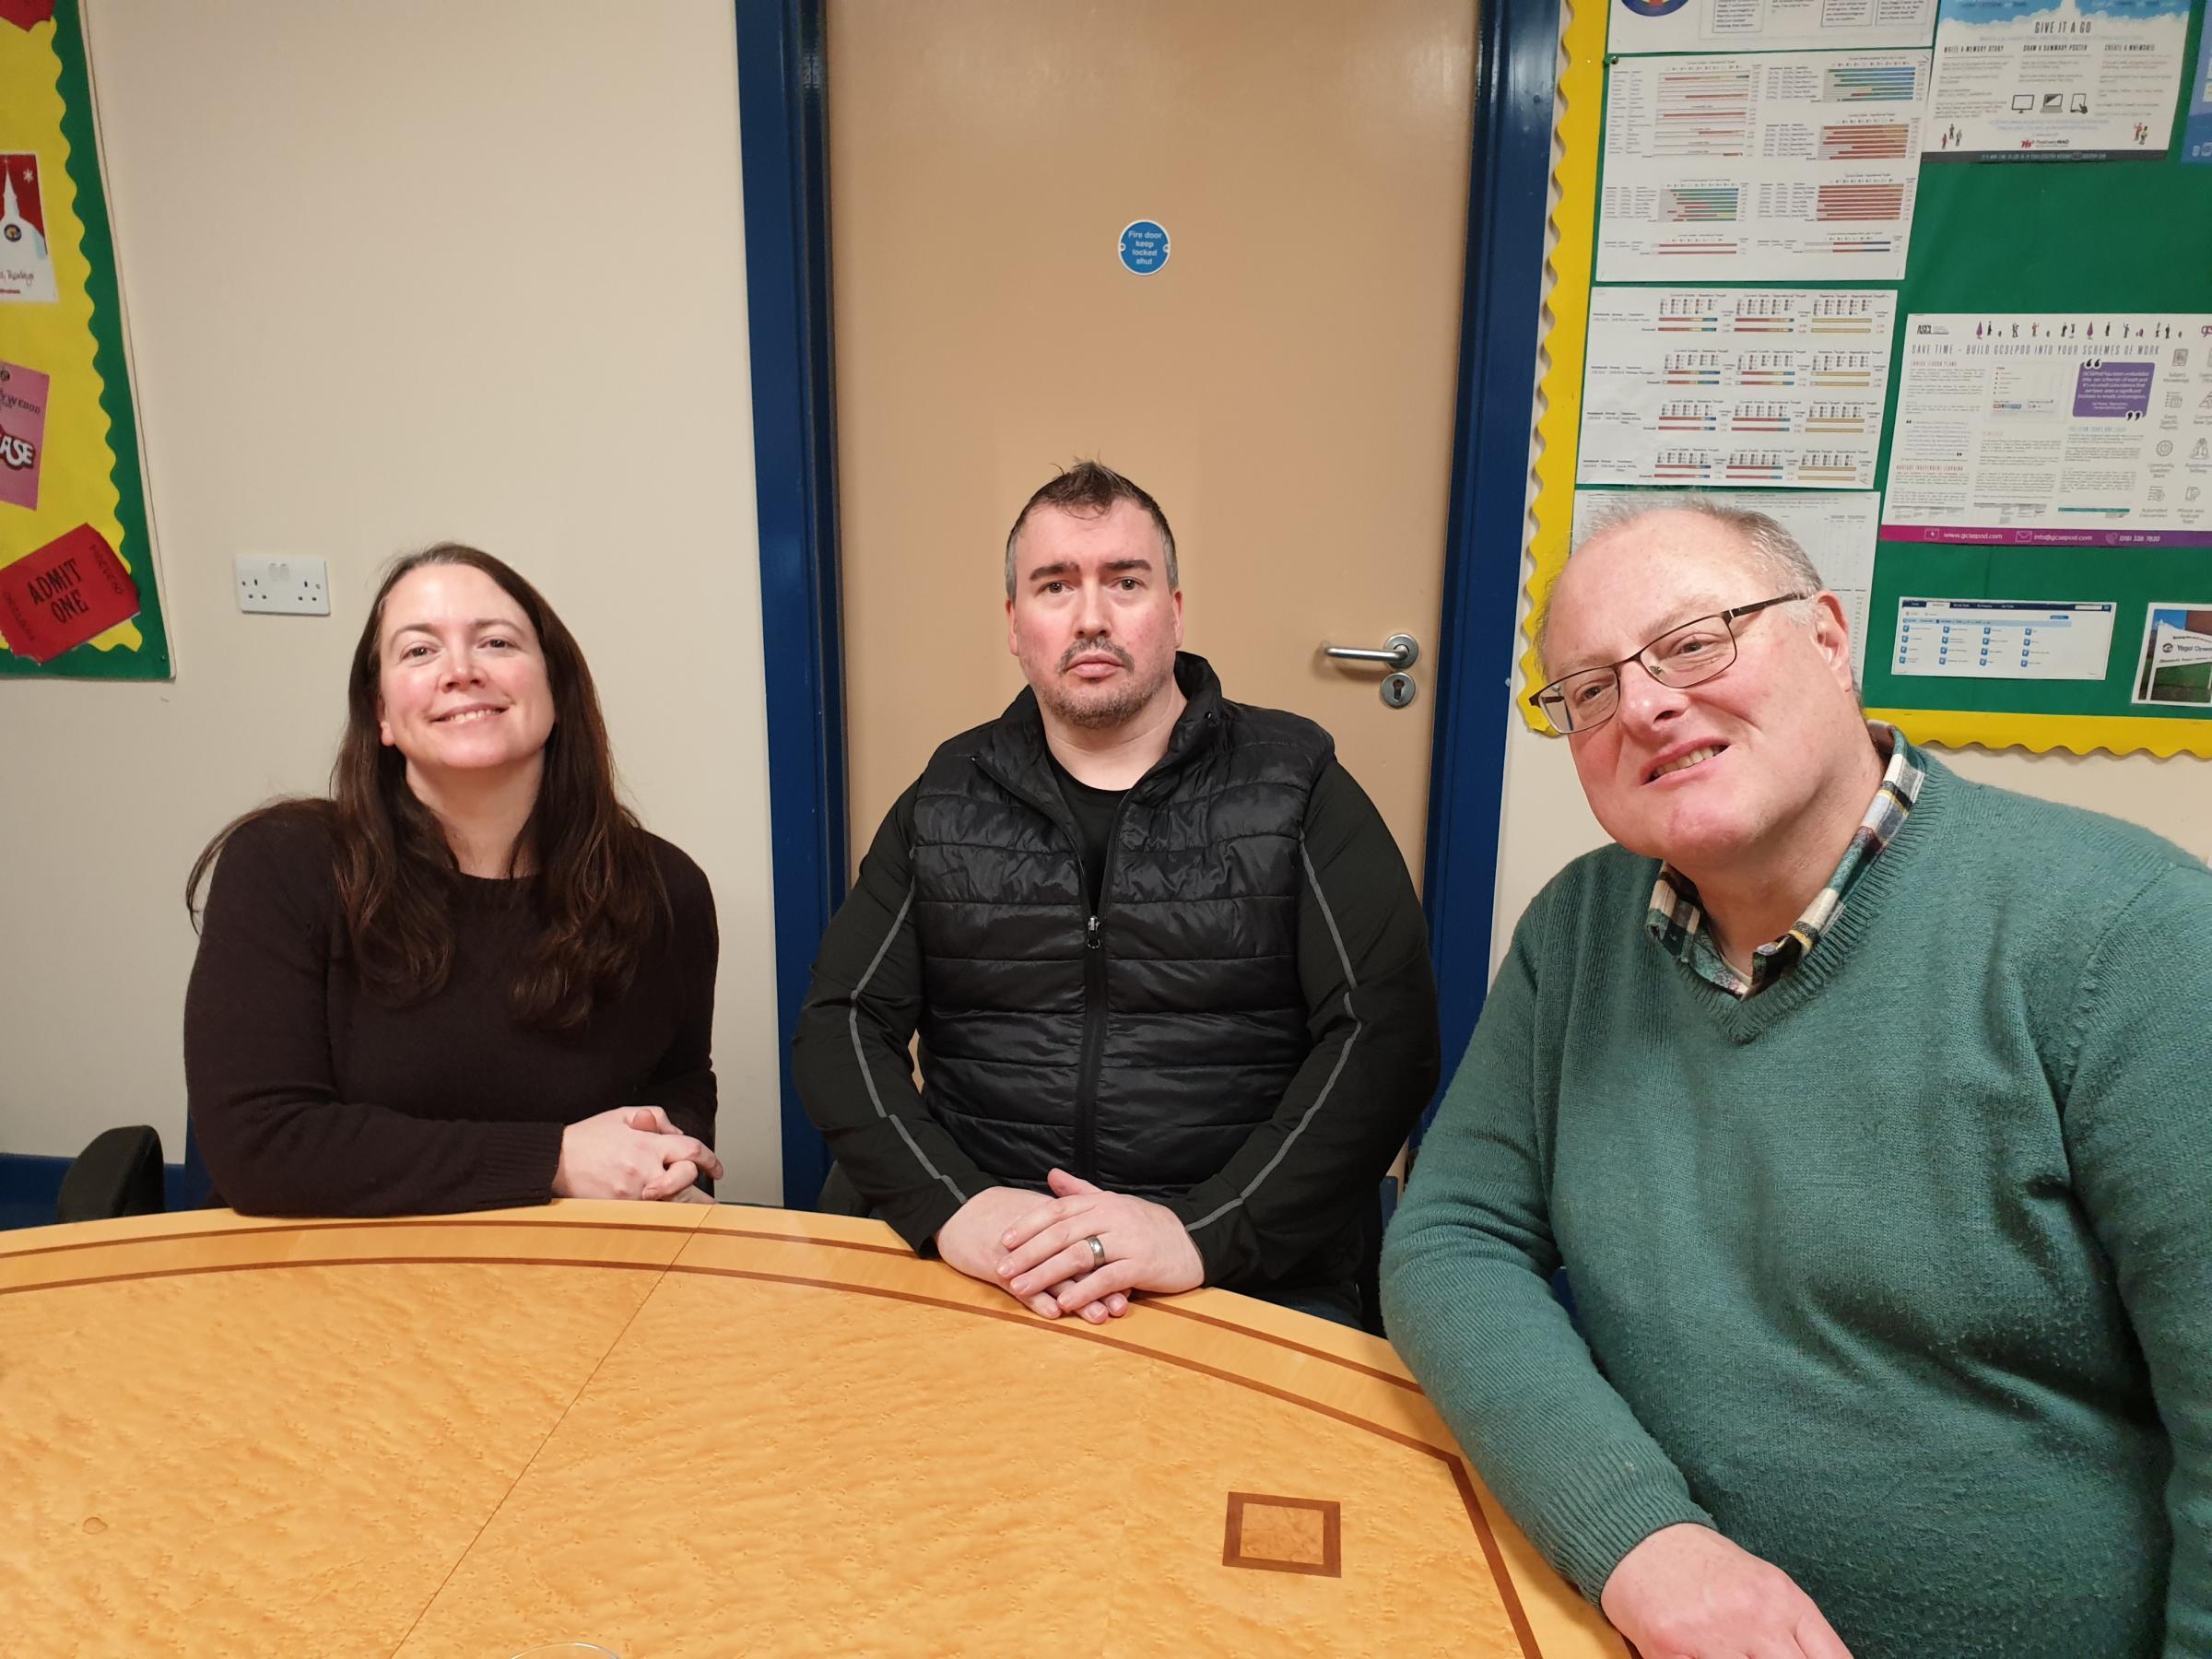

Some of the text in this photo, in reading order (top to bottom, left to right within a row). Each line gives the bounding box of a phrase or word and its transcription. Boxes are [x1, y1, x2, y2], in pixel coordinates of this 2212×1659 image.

[2034, 21, 2091, 34] GIVE IT A GO
[1135, 240, 1154, 249] keep
[1135, 257, 1153, 265] shut
[1912, 345, 1931, 355] SAVE
[1935, 345, 1954, 355] TIME
[1965, 345, 1990, 355] BUILD
[1994, 345, 2031, 355] GCSEPOD
[2034, 345, 2053, 355] INTO
[2057, 345, 2078, 355] YOUR
[2082, 345, 2121, 355] SCHEMES
[2124, 345, 2135, 355] OF
[2137, 345, 2160, 355] WORK
[0, 433, 34, 467] ASE
[1944, 532, 2003, 540] www.gcsepod.com
[28, 558, 82, 606] ADMIT
[50, 588, 89, 624] ONE
